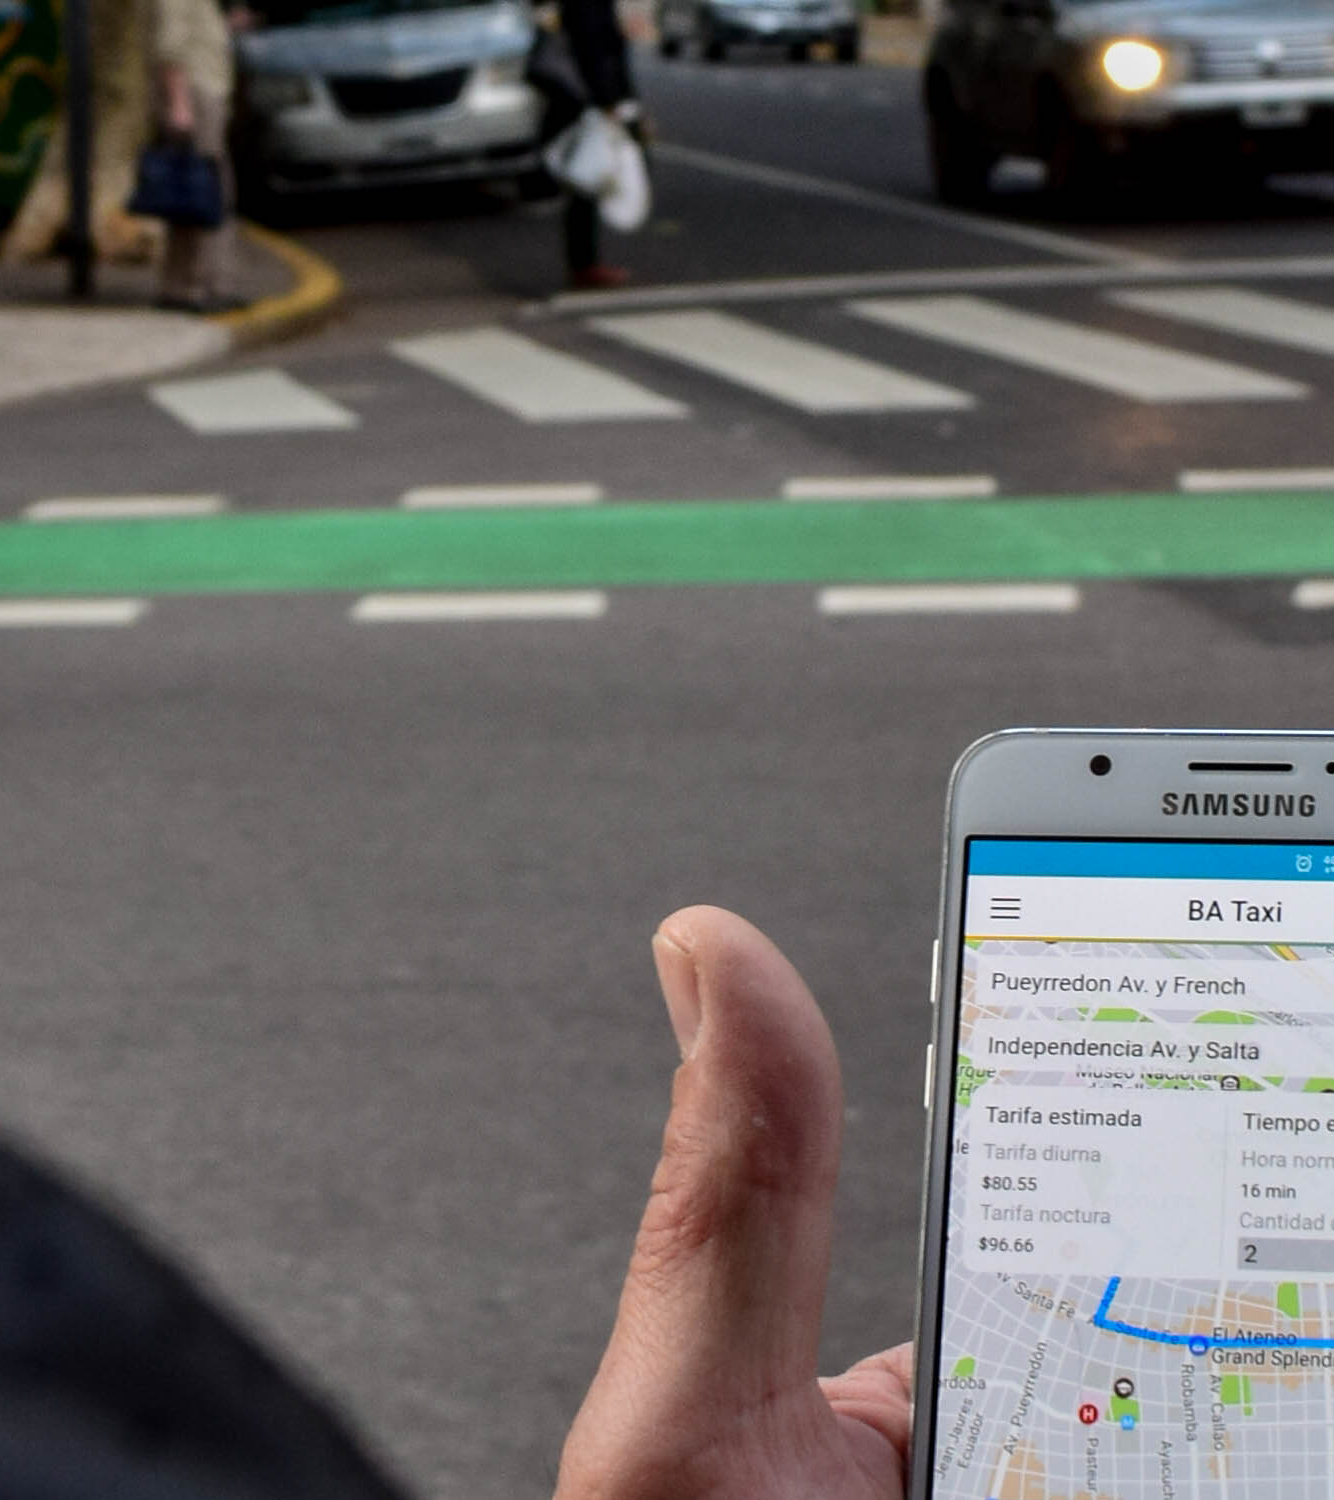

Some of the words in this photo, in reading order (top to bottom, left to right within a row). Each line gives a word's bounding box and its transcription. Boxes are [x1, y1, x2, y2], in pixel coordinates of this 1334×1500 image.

[1162, 792, 1316, 817] SAMSUNG
[1188, 900, 1224, 921] BA
[1232, 901, 1282, 923] Taxi
[992, 973, 1111, 995] Pueyrredon
[1118, 976, 1148, 993] Av.
[1155, 979, 1167, 997] y
[1174, 976, 1246, 995] French
[988, 1037, 1143, 1058] Independencia
[1150, 1040, 1180, 1059] Av.
[1188, 1044, 1200, 1062] y
[1206, 1041, 1259, 1061] Salta
[986, 1106, 1042, 1124] Tarifa
[1049, 1110, 1142, 1127] estimada
[1243, 1112, 1320, 1135] Tiempo
[984, 1143, 1037, 1161] Tarifa
[1241, 1151, 1287, 1168] Hora
[981, 1176, 1037, 1191] $80.55
[1241, 1184, 1261, 1198] 16
[1265, 1186, 1296, 1199] min
[981, 1204, 1034, 1222] Tarifa
[1039, 1206, 1111, 1224] noctura
[1240, 1212, 1325, 1231] Cantidad
[979, 1237, 1034, 1252] $96.66
[1244, 1244, 1258, 1263] 2
[1014, 1281, 1054, 1310] Santa
[1057, 1300, 1075, 1318] Fe
[1235, 1328, 1297, 1345] Ateneo
[1212, 1348, 1265, 1366] Grand
